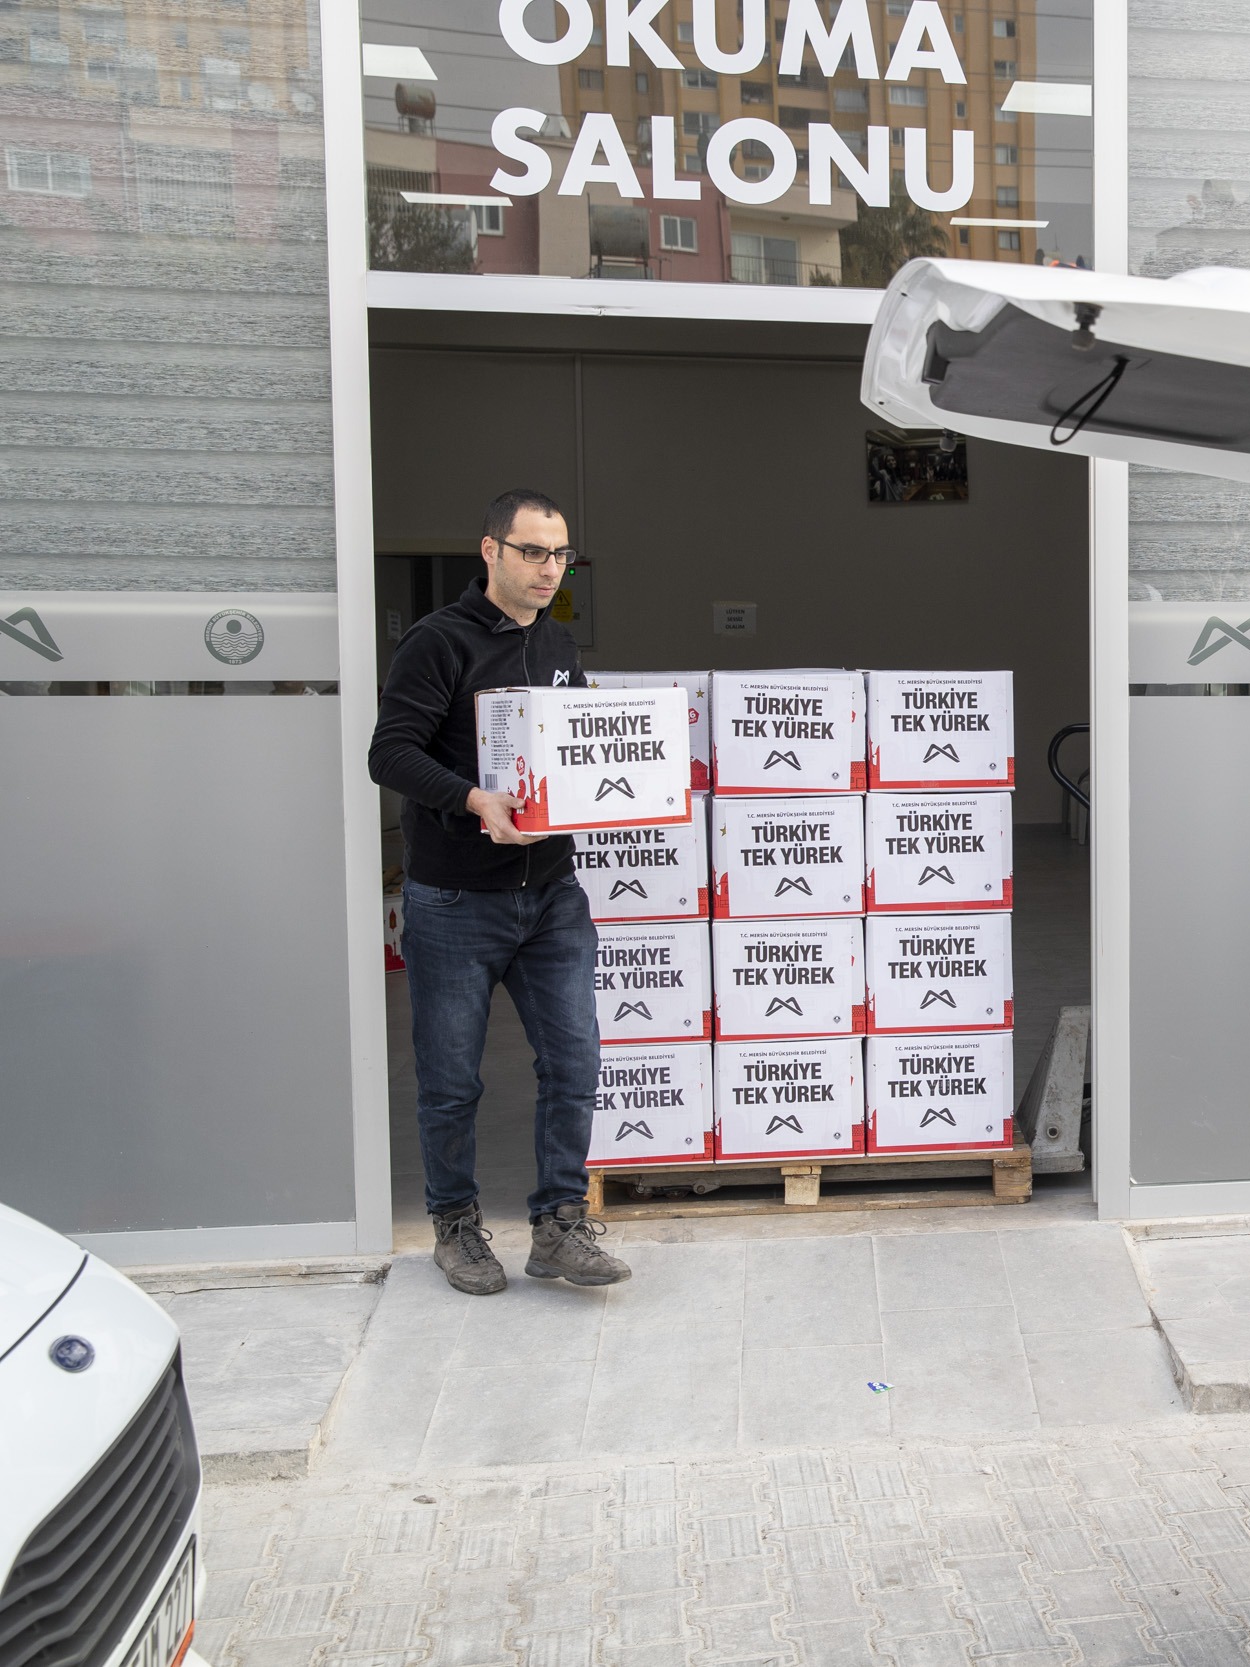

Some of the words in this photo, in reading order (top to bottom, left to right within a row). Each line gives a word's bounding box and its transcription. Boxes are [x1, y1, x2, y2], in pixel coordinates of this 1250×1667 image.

[498, 0, 967, 84] OKUMA
[489, 107, 974, 212] SALONU
[744, 693, 822, 716] TÜRKİYE
[902, 688, 977, 709] TÜRKİYE
[568, 711, 651, 738] TÜRKİYE
[732, 719, 767, 737] TEK
[772, 717, 834, 739] YÜREK
[891, 715, 925, 732] TEK
[929, 710, 990, 731] YÜREK
[557, 744, 596, 766] TEK
[600, 738, 665, 763] YÜREK
[752, 820, 830, 844] TÜRKİYE
[896, 810, 972, 833] TÜRKİYE
[741, 848, 777, 866] TEK
[780, 843, 843, 865] YÜREK
[885, 837, 920, 855] TEK
[924, 832, 985, 853] YÜREK
[614, 845, 679, 867] YÜREK
[744, 941, 822, 962] TÜRKİYE
[899, 934, 975, 958] TÜRKİYE
[594, 973, 616, 990] EK
[620, 967, 684, 989] YÜREK
[733, 968, 768, 985] TEK
[772, 964, 834, 985] YÜREK
[888, 962, 922, 979] TEK
[927, 957, 987, 978] YÜREK
[599, 1064, 670, 1087] ÜRKİYE
[744, 1059, 821, 1083] TÜRKİYE
[899, 1053, 975, 1076] TÜRKİYE
[732, 1087, 768, 1104] TEK
[772, 1082, 834, 1103] YÜREK
[888, 1080, 922, 1097] TEK
[926, 1075, 986, 1096] YÜREK
[594, 1093, 616, 1110] EK
[620, 1087, 684, 1109] YÜREK
